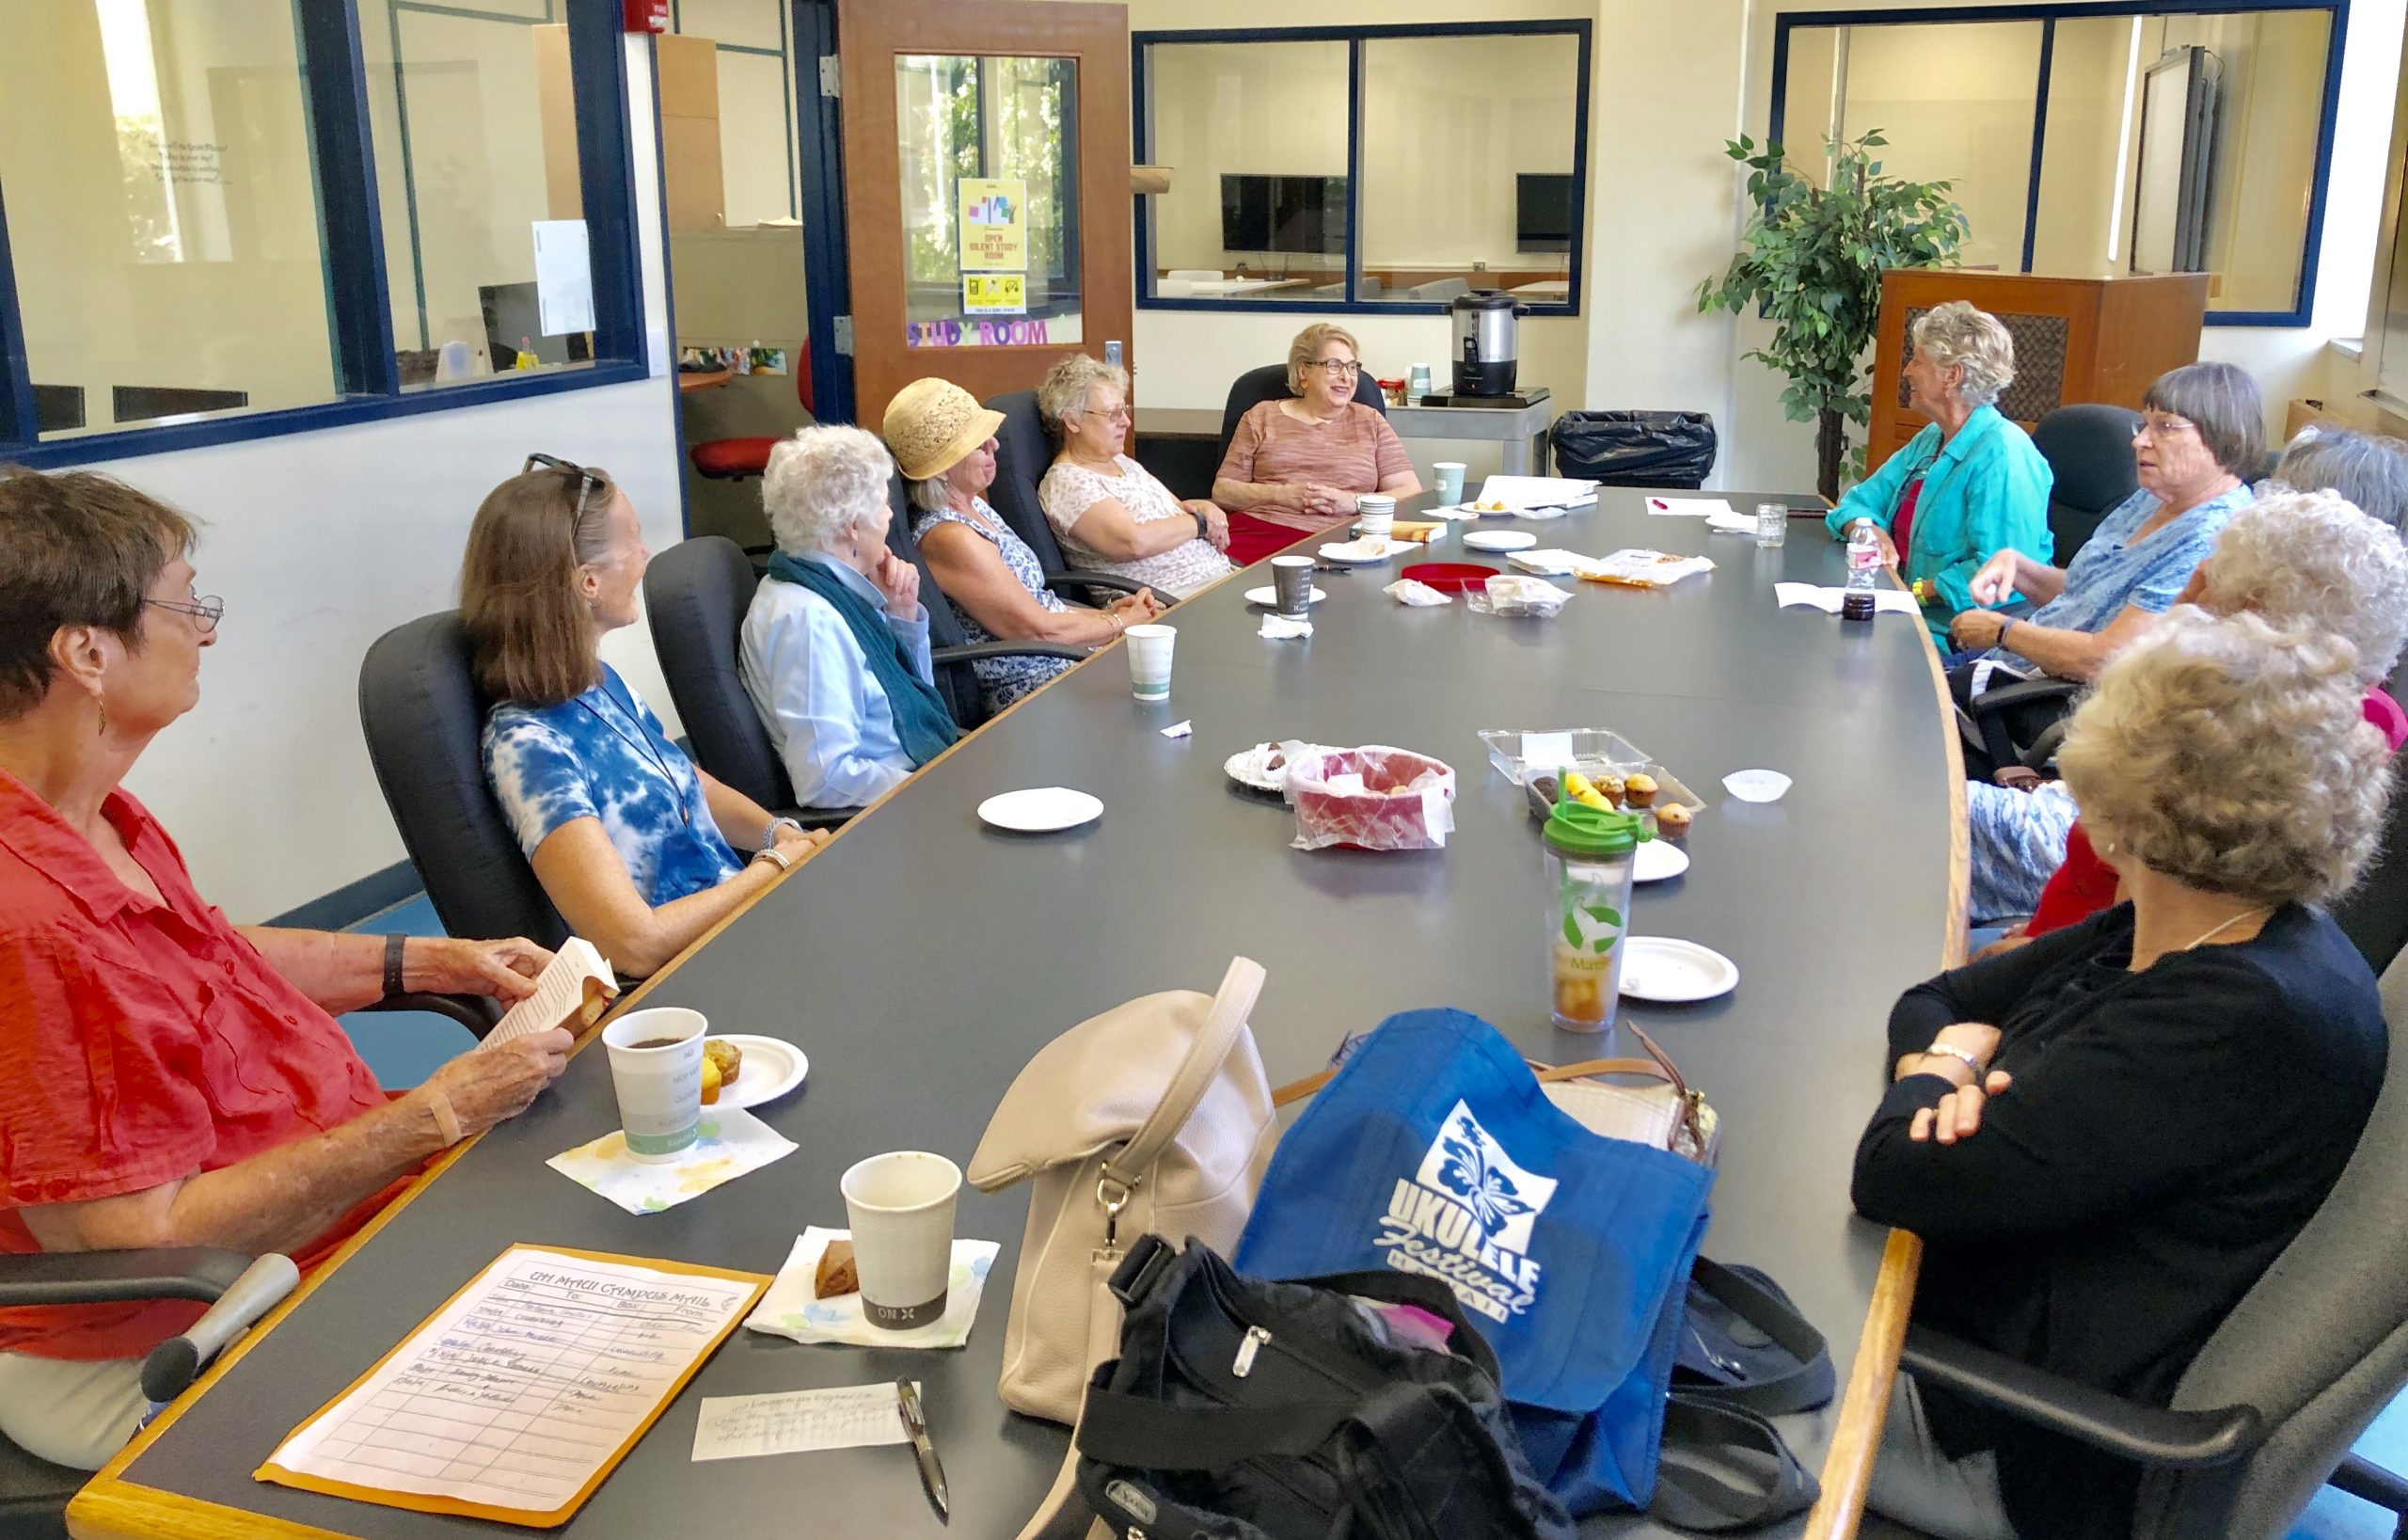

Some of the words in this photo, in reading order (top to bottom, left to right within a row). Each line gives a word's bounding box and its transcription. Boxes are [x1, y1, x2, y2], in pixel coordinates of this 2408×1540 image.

[970, 243, 993, 251] SILENT
[996, 243, 1017, 251] STUDY
[908, 321, 973, 348] STUDY
[979, 320, 1048, 346] ROOM
[1388, 1178, 1542, 1295] UKULELE
[1373, 1215, 1535, 1314] Festival
[530, 1271, 554, 1283] UH
[555, 1275, 598, 1291] MAUI
[600, 1281, 668, 1301] CAMPUS
[669, 1293, 710, 1308] MAIL
[878, 1308, 897, 1320] ON
